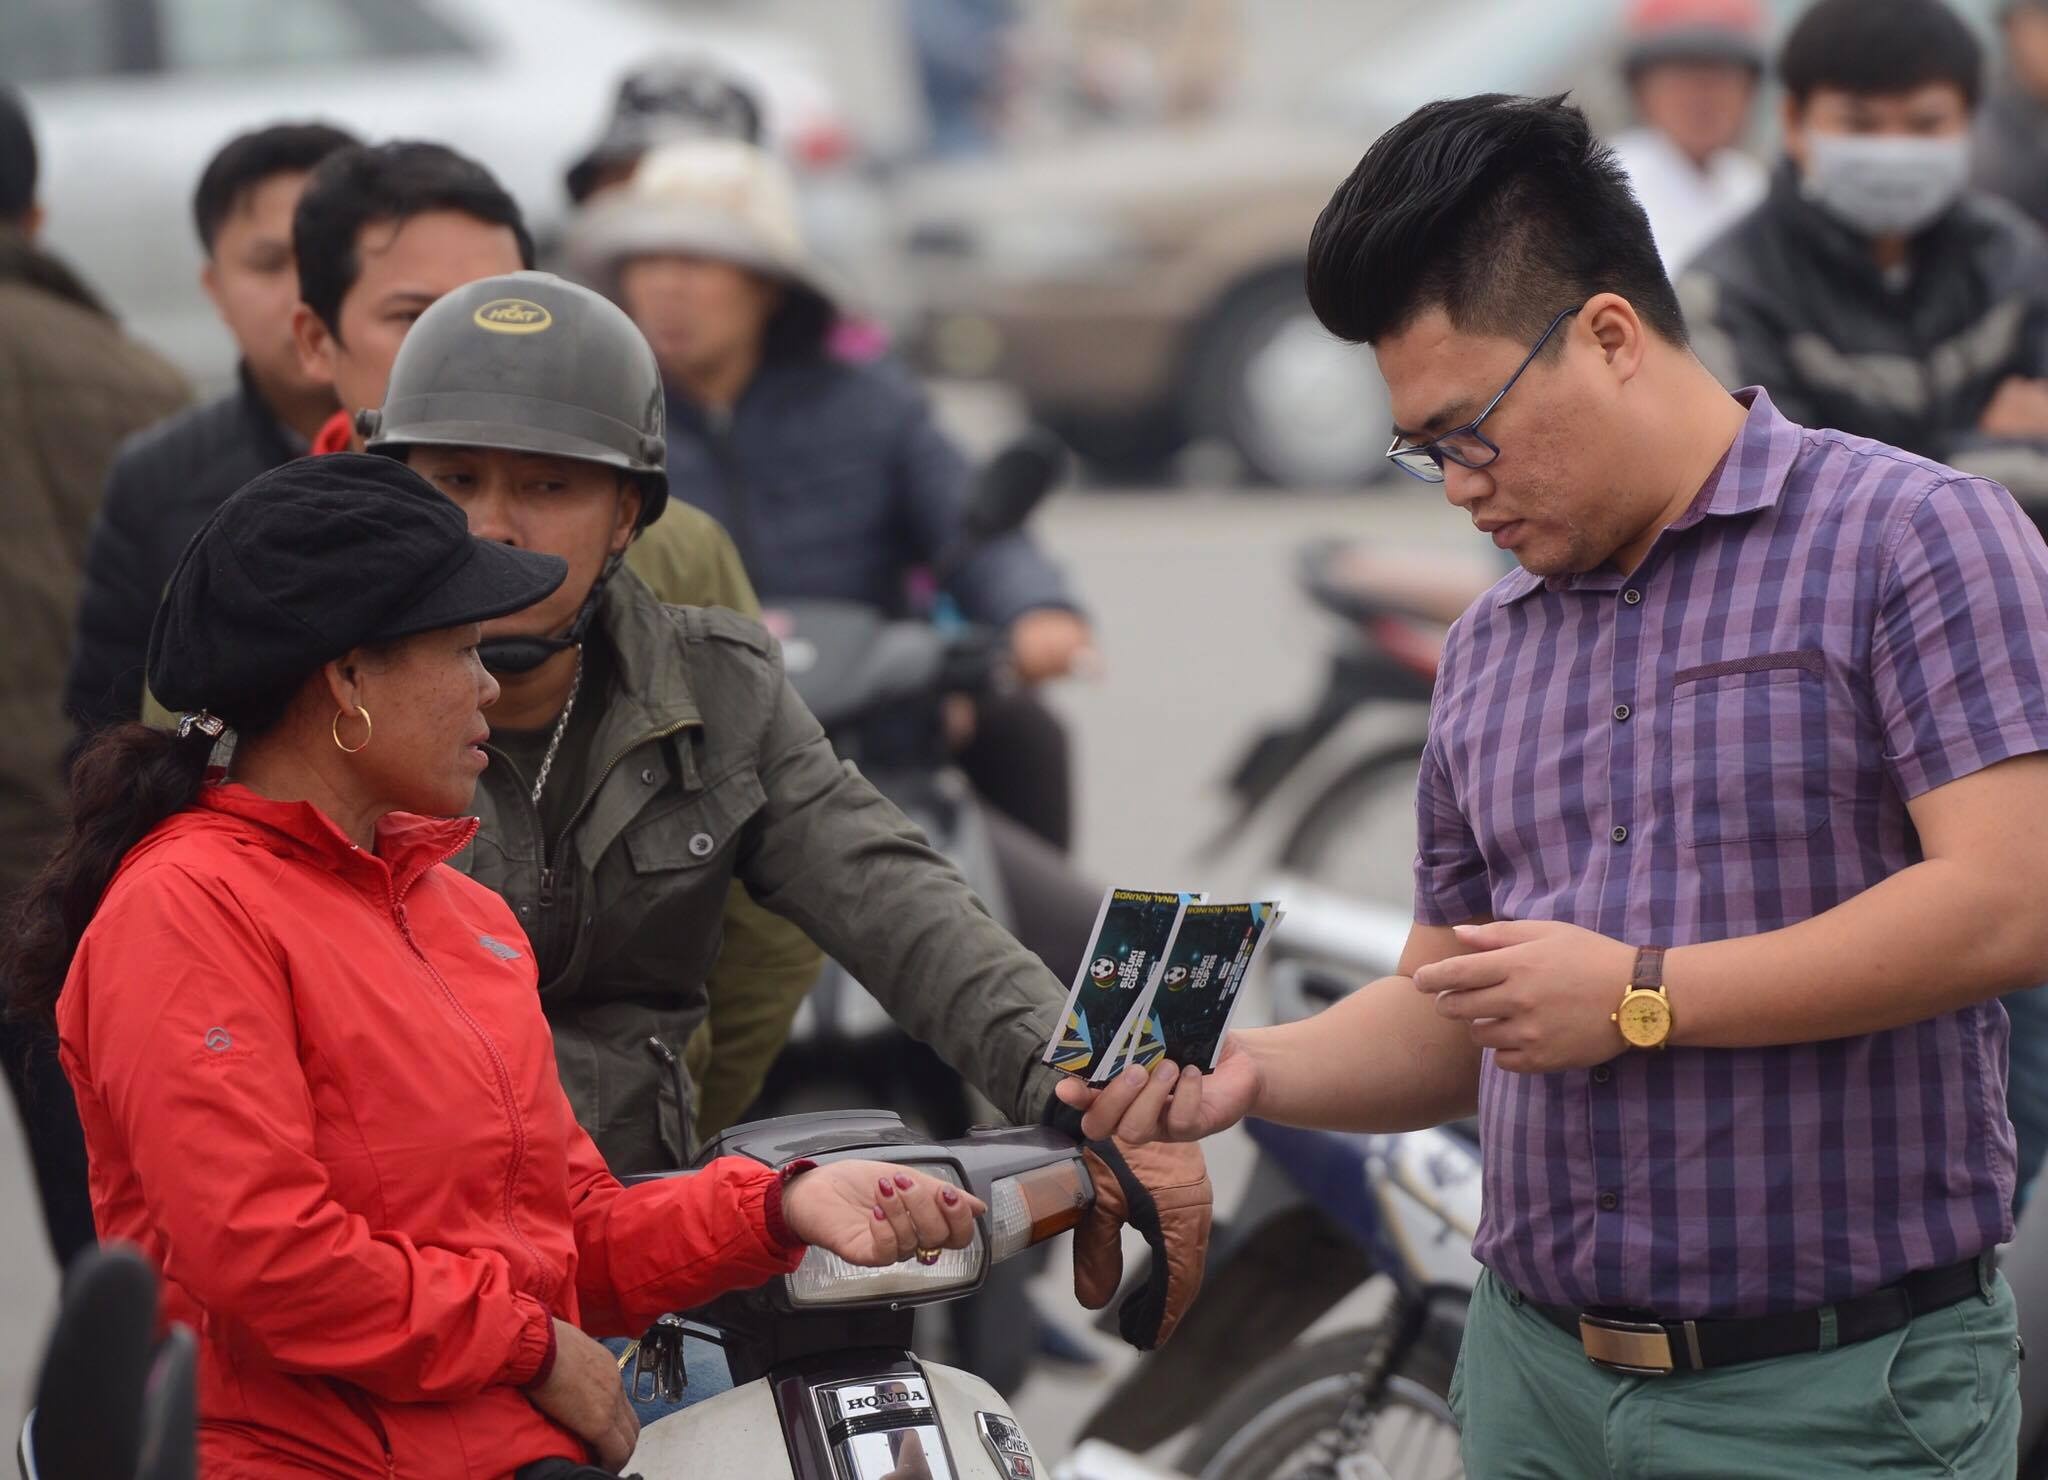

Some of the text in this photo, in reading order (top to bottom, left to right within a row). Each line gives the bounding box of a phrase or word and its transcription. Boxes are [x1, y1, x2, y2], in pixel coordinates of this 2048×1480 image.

[1114, 891, 1178, 904] FINAL ROUNDS
[1120, 950, 1139, 988] SUZUKI
[1128, 967, 1139, 988] CUP
[847, 1390, 925, 1410] HONDA
[999, 1437, 1029, 1453] POWER
